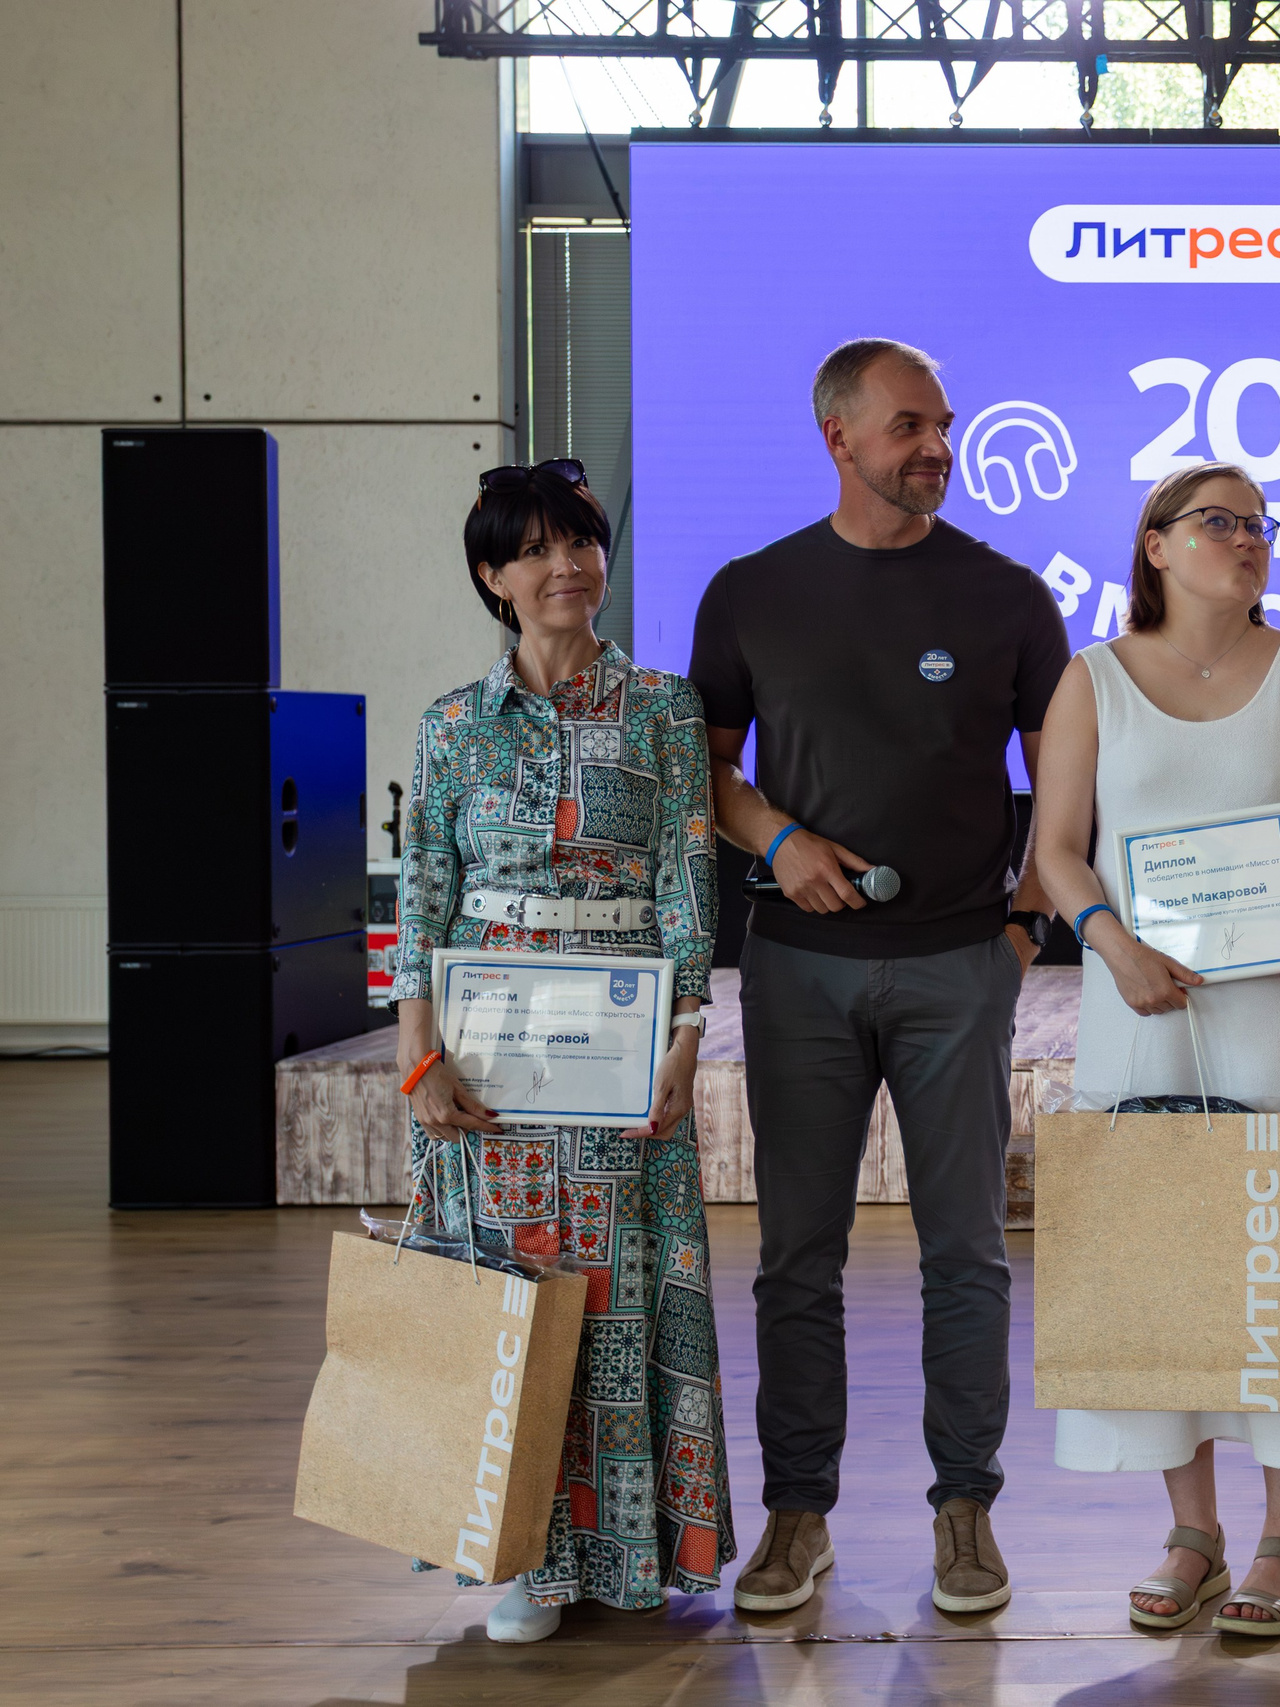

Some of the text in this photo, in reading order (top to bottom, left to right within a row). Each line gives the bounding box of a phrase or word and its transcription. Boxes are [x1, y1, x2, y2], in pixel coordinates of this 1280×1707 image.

[927, 653, 937, 661] 20
[1141, 840, 1177, 851] Литрес
[1144, 856, 1196, 873] Диплом
[1147, 870, 1194, 883] победителю
[1201, 863, 1244, 876] номинации
[1245, 859, 1271, 868] «Мисс
[1191, 883, 1267, 904] Макаровой
[462, 971, 501, 980] Литрес
[613, 980, 624, 988] 20
[461, 989, 518, 1002] Диплом
[613, 993, 635, 1001] вместе
[462, 1006, 513, 1014] победителю
[460, 1029, 590, 1045] Марине Флеровой
[454, 1330, 521, 1580] Литрес
